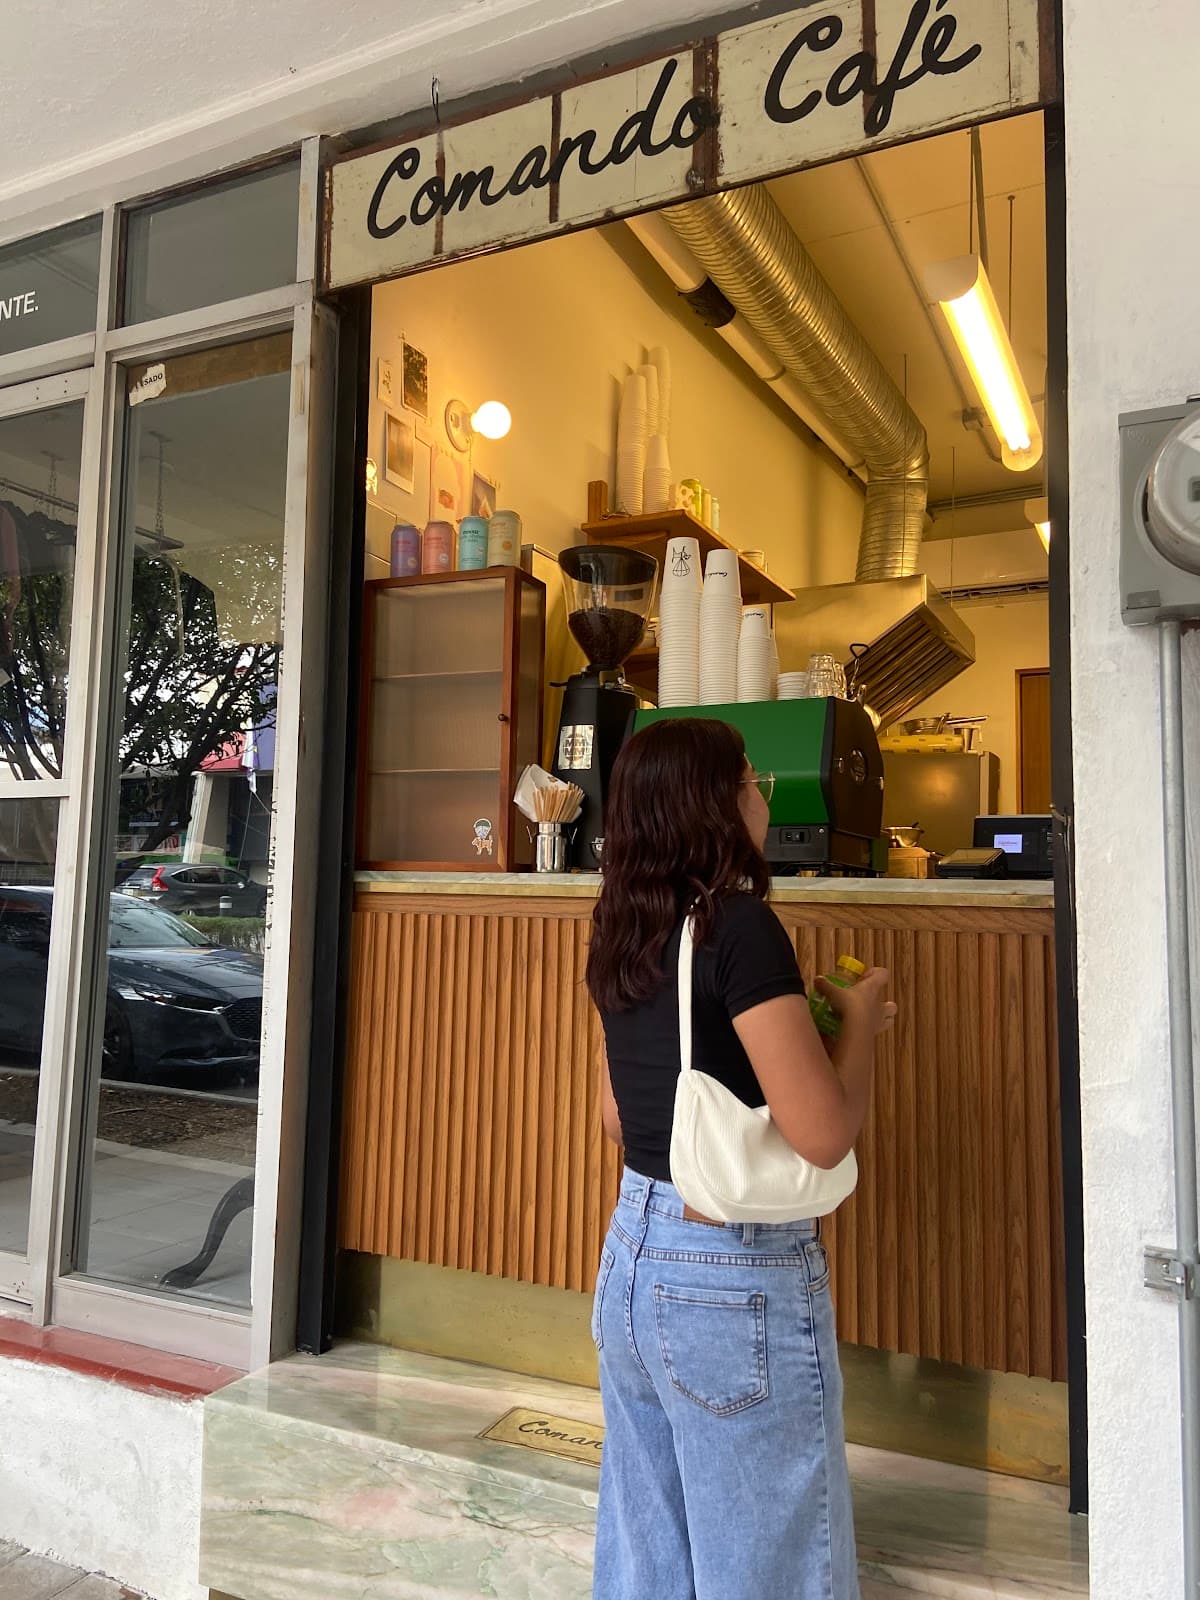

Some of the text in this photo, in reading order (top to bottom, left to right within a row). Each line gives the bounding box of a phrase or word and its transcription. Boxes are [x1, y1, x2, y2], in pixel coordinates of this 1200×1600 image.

[367, 0, 982, 239] Comando Café
[0, 291, 39, 320] NTE.
